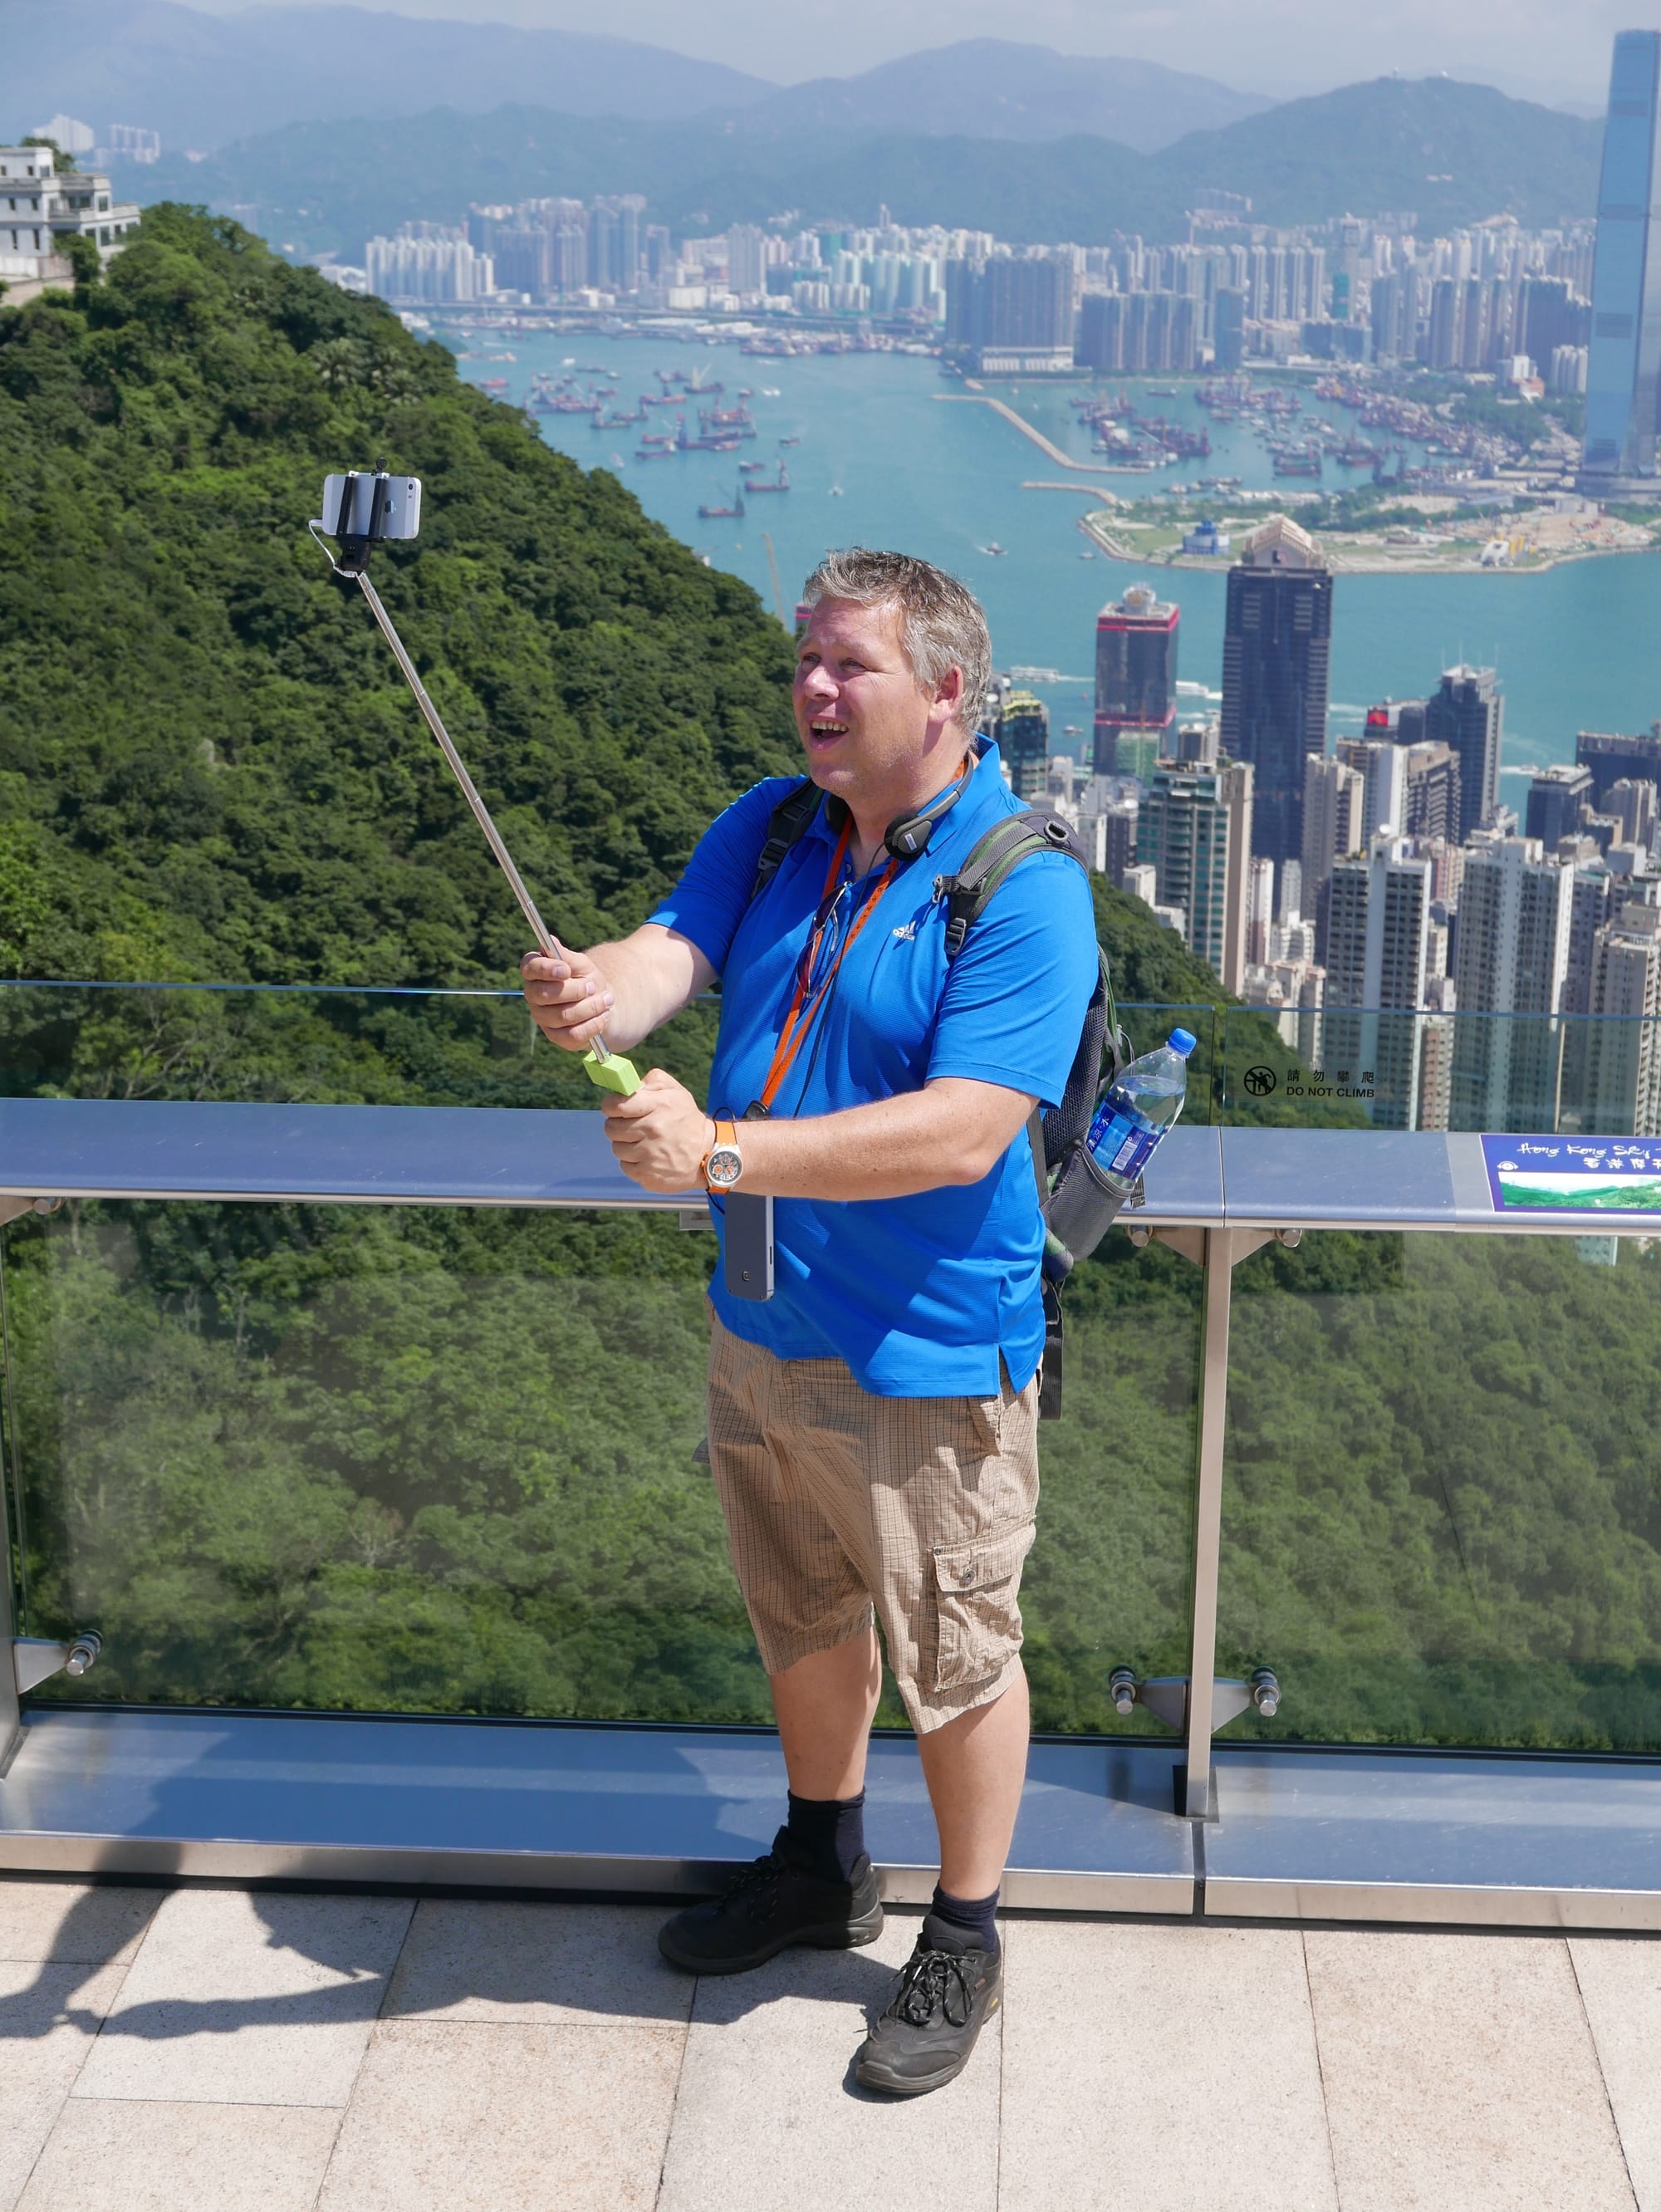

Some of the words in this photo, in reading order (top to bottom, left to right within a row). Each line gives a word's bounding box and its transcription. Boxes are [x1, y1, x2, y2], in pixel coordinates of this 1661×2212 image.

[1287, 1069, 1374, 1083] 請勿攀爬
[1286, 1086, 1304, 1096] DO
[1308, 1087, 1333, 1096] NOT
[1336, 1088, 1374, 1097] CLIMB
[1516, 1143, 1561, 1157] Hong
[1566, 1144, 1607, 1158] Kong
